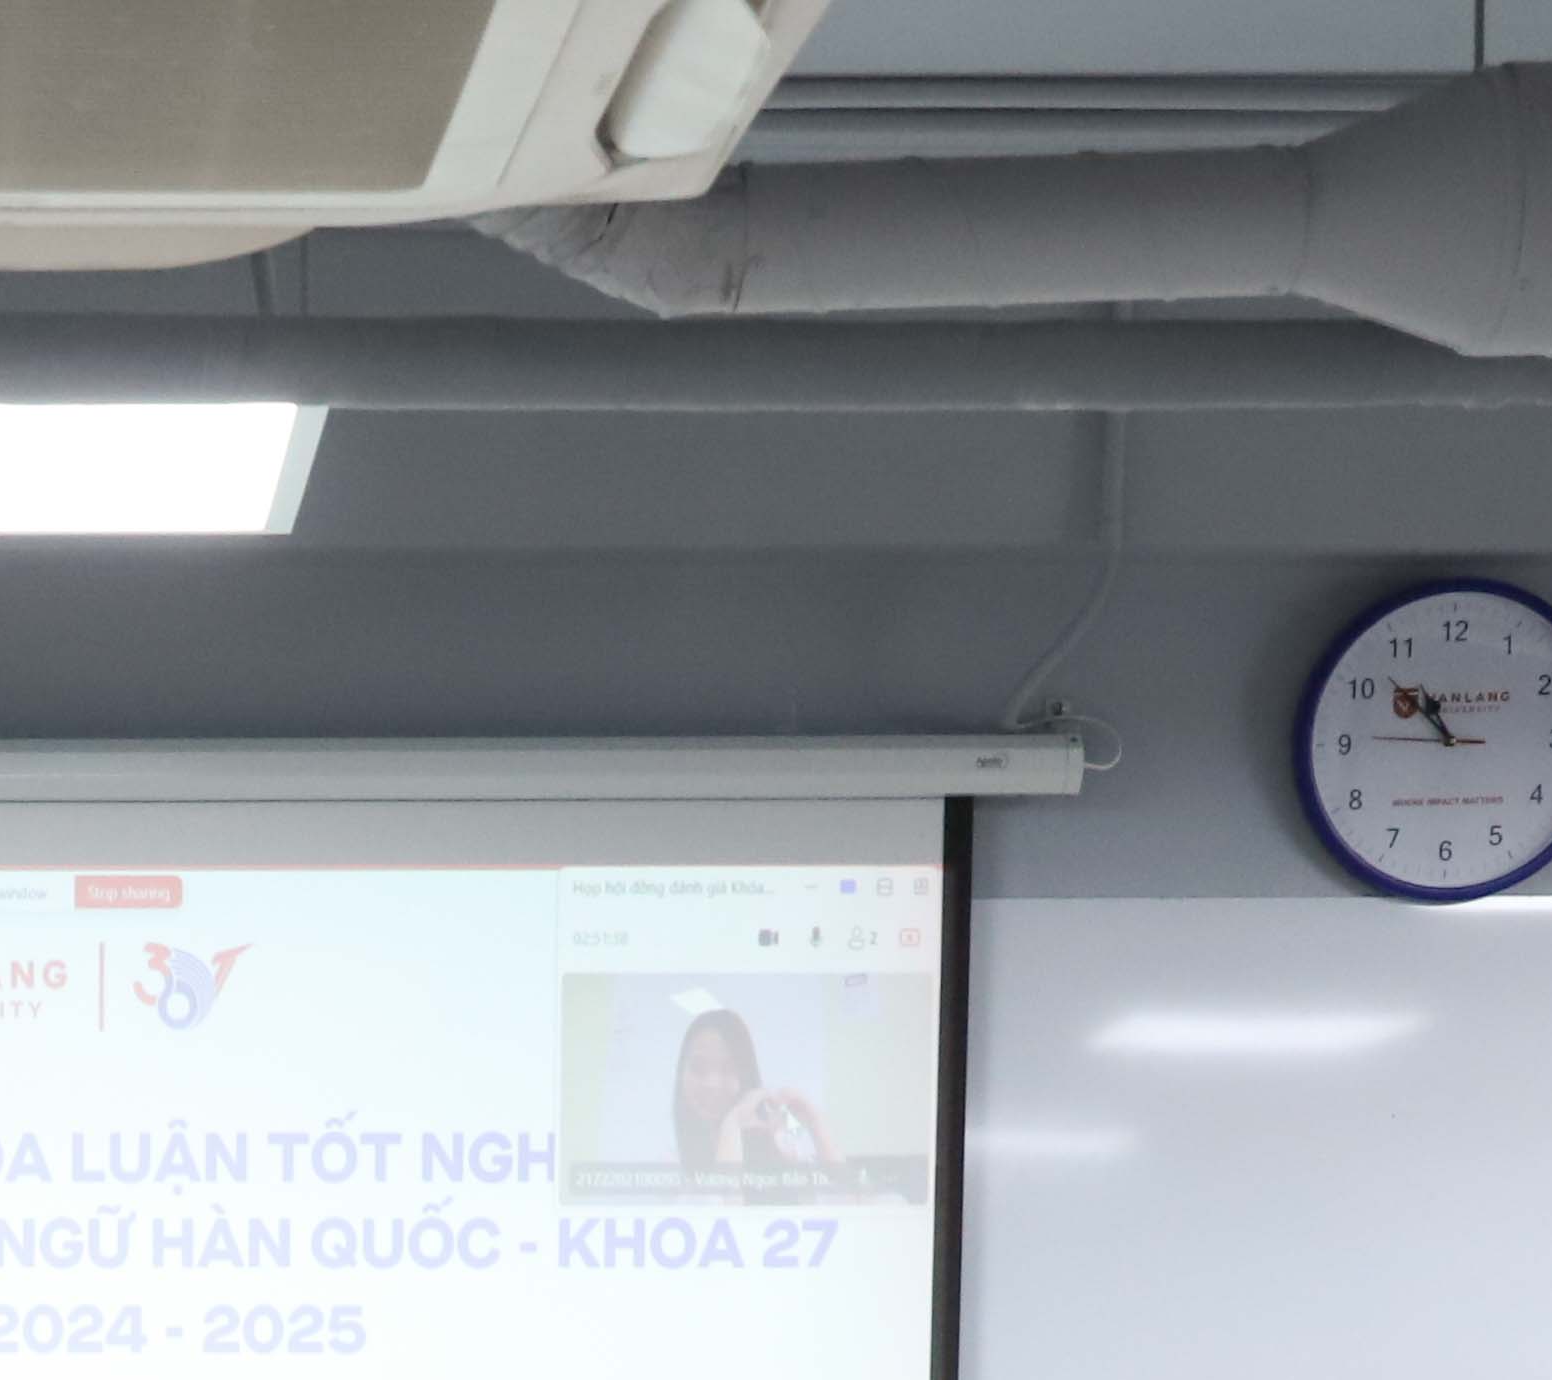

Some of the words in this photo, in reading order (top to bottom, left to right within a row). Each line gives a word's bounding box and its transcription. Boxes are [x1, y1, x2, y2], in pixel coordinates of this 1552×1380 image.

[1443, 620, 1468, 642] 12
[1390, 639, 1413, 658] 11
[1503, 635, 1512, 654] 1
[1348, 679, 1374, 699] 10
[1538, 675, 1551, 695] 2
[1338, 735, 1351, 755] 9
[1349, 790, 1362, 810] 8
[1530, 785, 1542, 804] 4
[1386, 829, 1399, 847] 7
[1489, 826, 1502, 845] 5
[1439, 841, 1452, 860] 6
[122, 885, 170, 903] sharing
[71, 1121, 247, 1196] LUẬN
[268, 1110, 402, 1183] TỐT
[422, 1131, 557, 1183] NGH
[152, 1205, 291, 1268] HÀN
[310, 1197, 500, 1270] QUỐC
[559, 1218, 745, 1269] KHOA
[762, 1218, 838, 1269] 27
[202, 1304, 367, 1354] 2025
